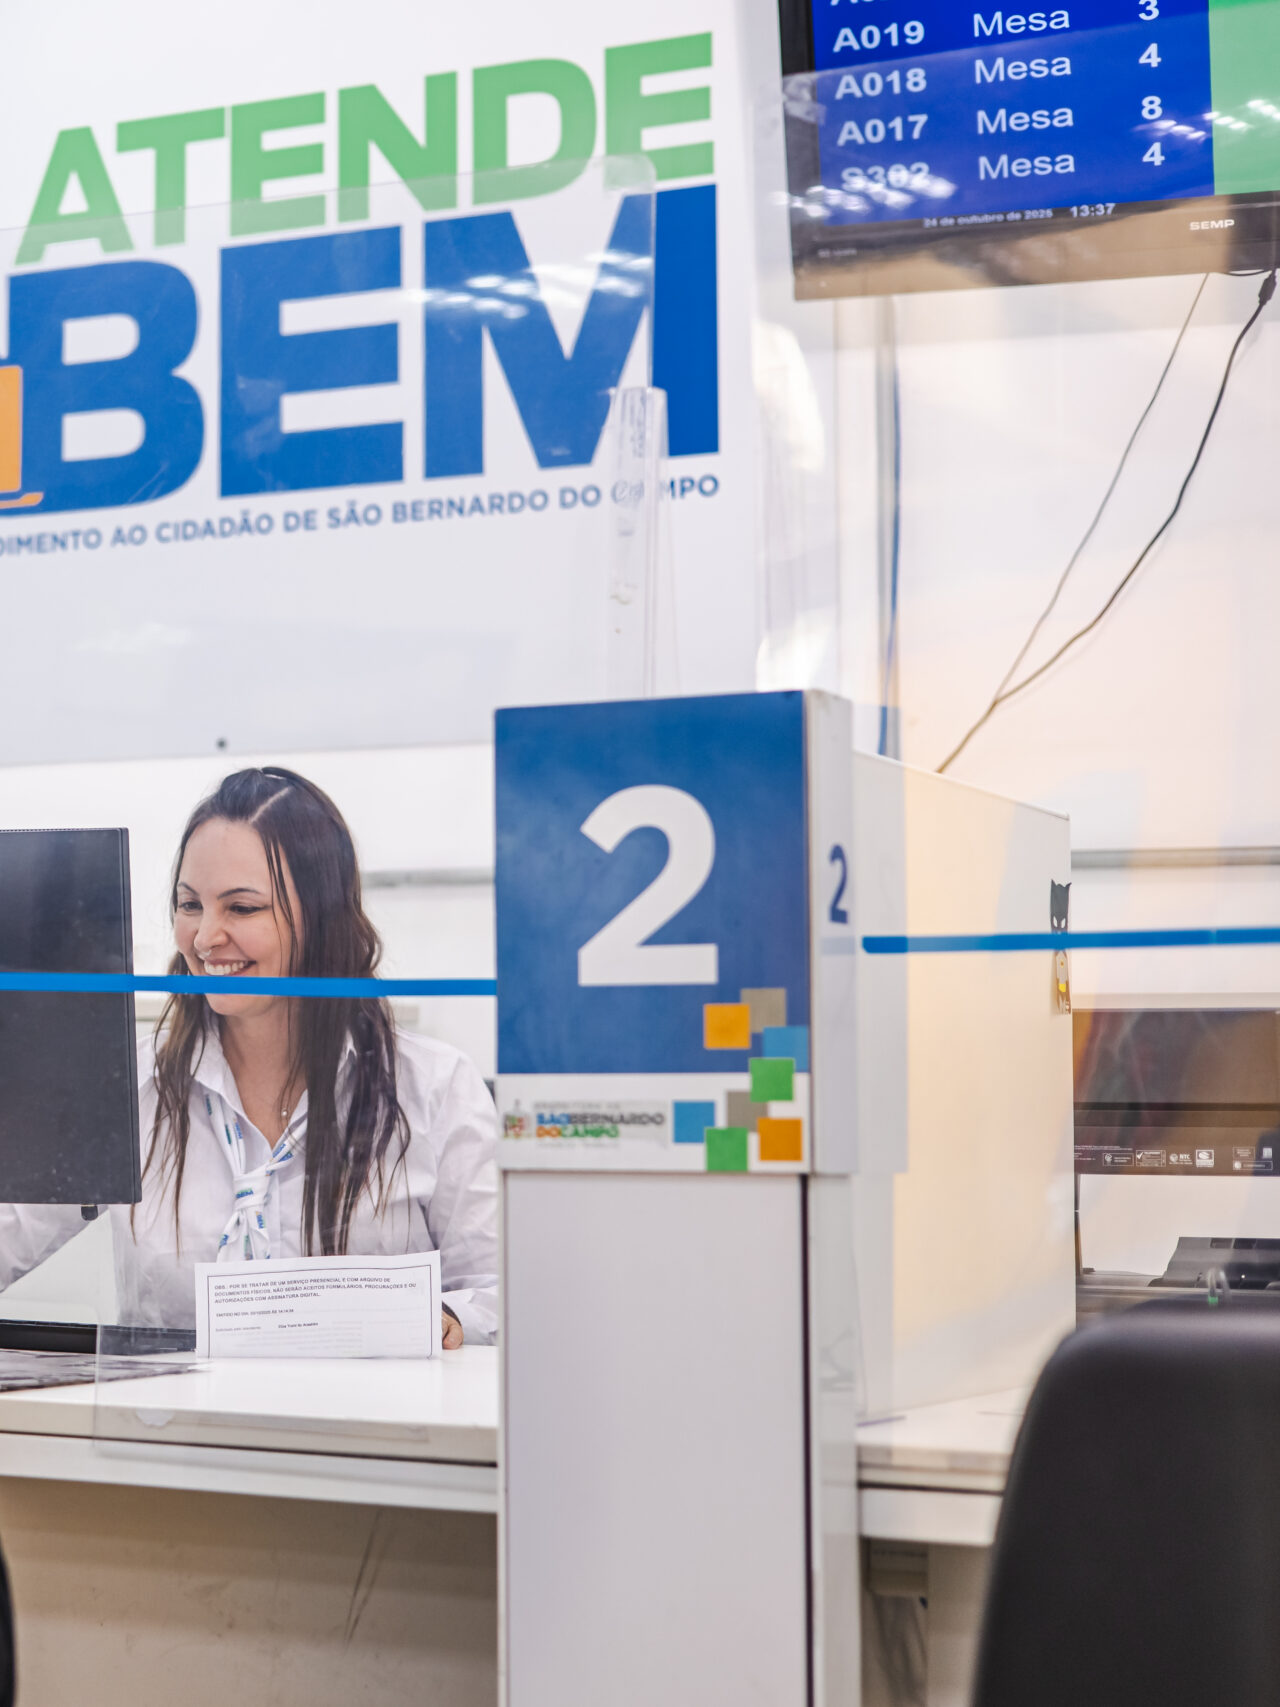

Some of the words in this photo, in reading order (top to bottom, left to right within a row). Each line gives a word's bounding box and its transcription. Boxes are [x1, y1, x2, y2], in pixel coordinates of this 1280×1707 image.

[832, 20, 925, 53] A019
[973, 9, 1071, 37] Mesa
[1138, 0, 1160, 20] 3
[834, 67, 928, 99] A018
[974, 55, 1072, 84] Mesa
[1138, 43, 1162, 68] 4
[14, 32, 715, 265] ATENDE
[836, 114, 929, 146] A017
[976, 106, 1074, 135] Mesa
[1141, 96, 1163, 120] 8
[978, 152, 1075, 181] Mesa
[1142, 142, 1165, 167] 4
[939, 216, 954, 227] de
[956, 213, 1004, 226] outubro
[1006, 210, 1021, 221] de
[1070, 202, 1116, 218] 13:37
[1189, 219, 1235, 230] SEMP
[8, 184, 720, 511] BEM
[110, 524, 148, 548] AO
[155, 510, 275, 544] CIDADÃO
[283, 509, 318, 533] DE
[327, 500, 383, 529] SÃO
[391, 489, 551, 524] BERNARDO
[558, 484, 602, 510] DO
[610, 474, 719, 506] CMPO
[578, 784, 719, 987] 2
[829, 844, 849, 925] 2
